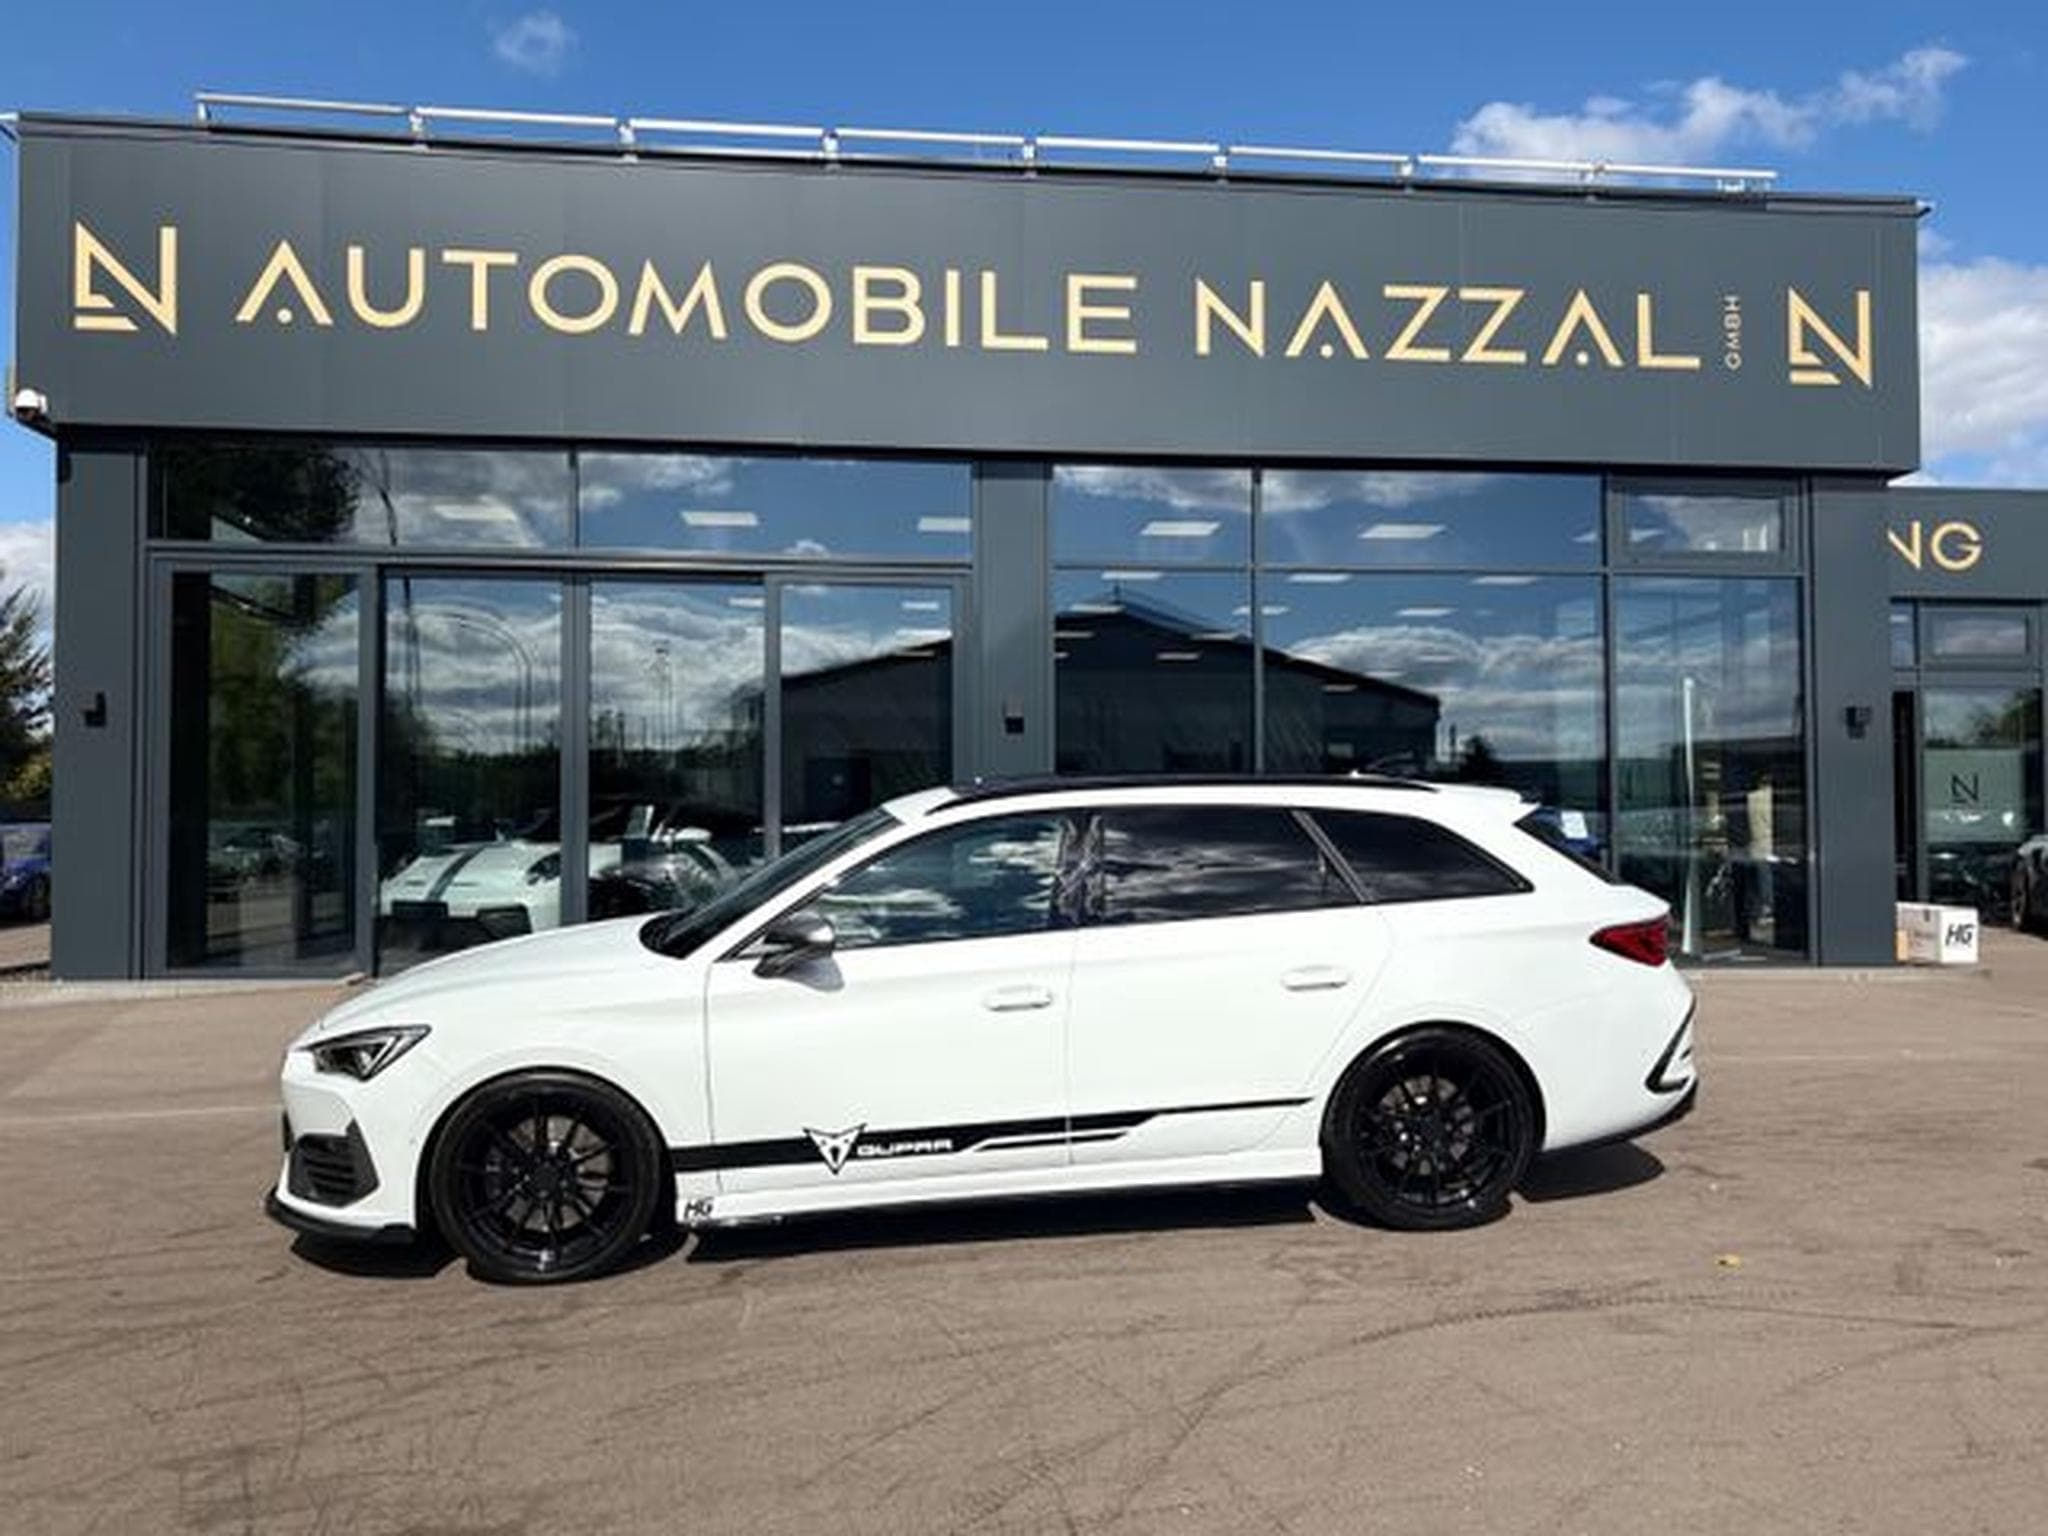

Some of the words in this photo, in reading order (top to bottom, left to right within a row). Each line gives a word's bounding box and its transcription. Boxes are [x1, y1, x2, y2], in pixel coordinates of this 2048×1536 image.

[73, 221, 178, 336] N
[236, 239, 1136, 356] AUTOMOBILE
[1194, 279, 1701, 370] NAZZAL
[1723, 295, 1742, 371] GMBH
